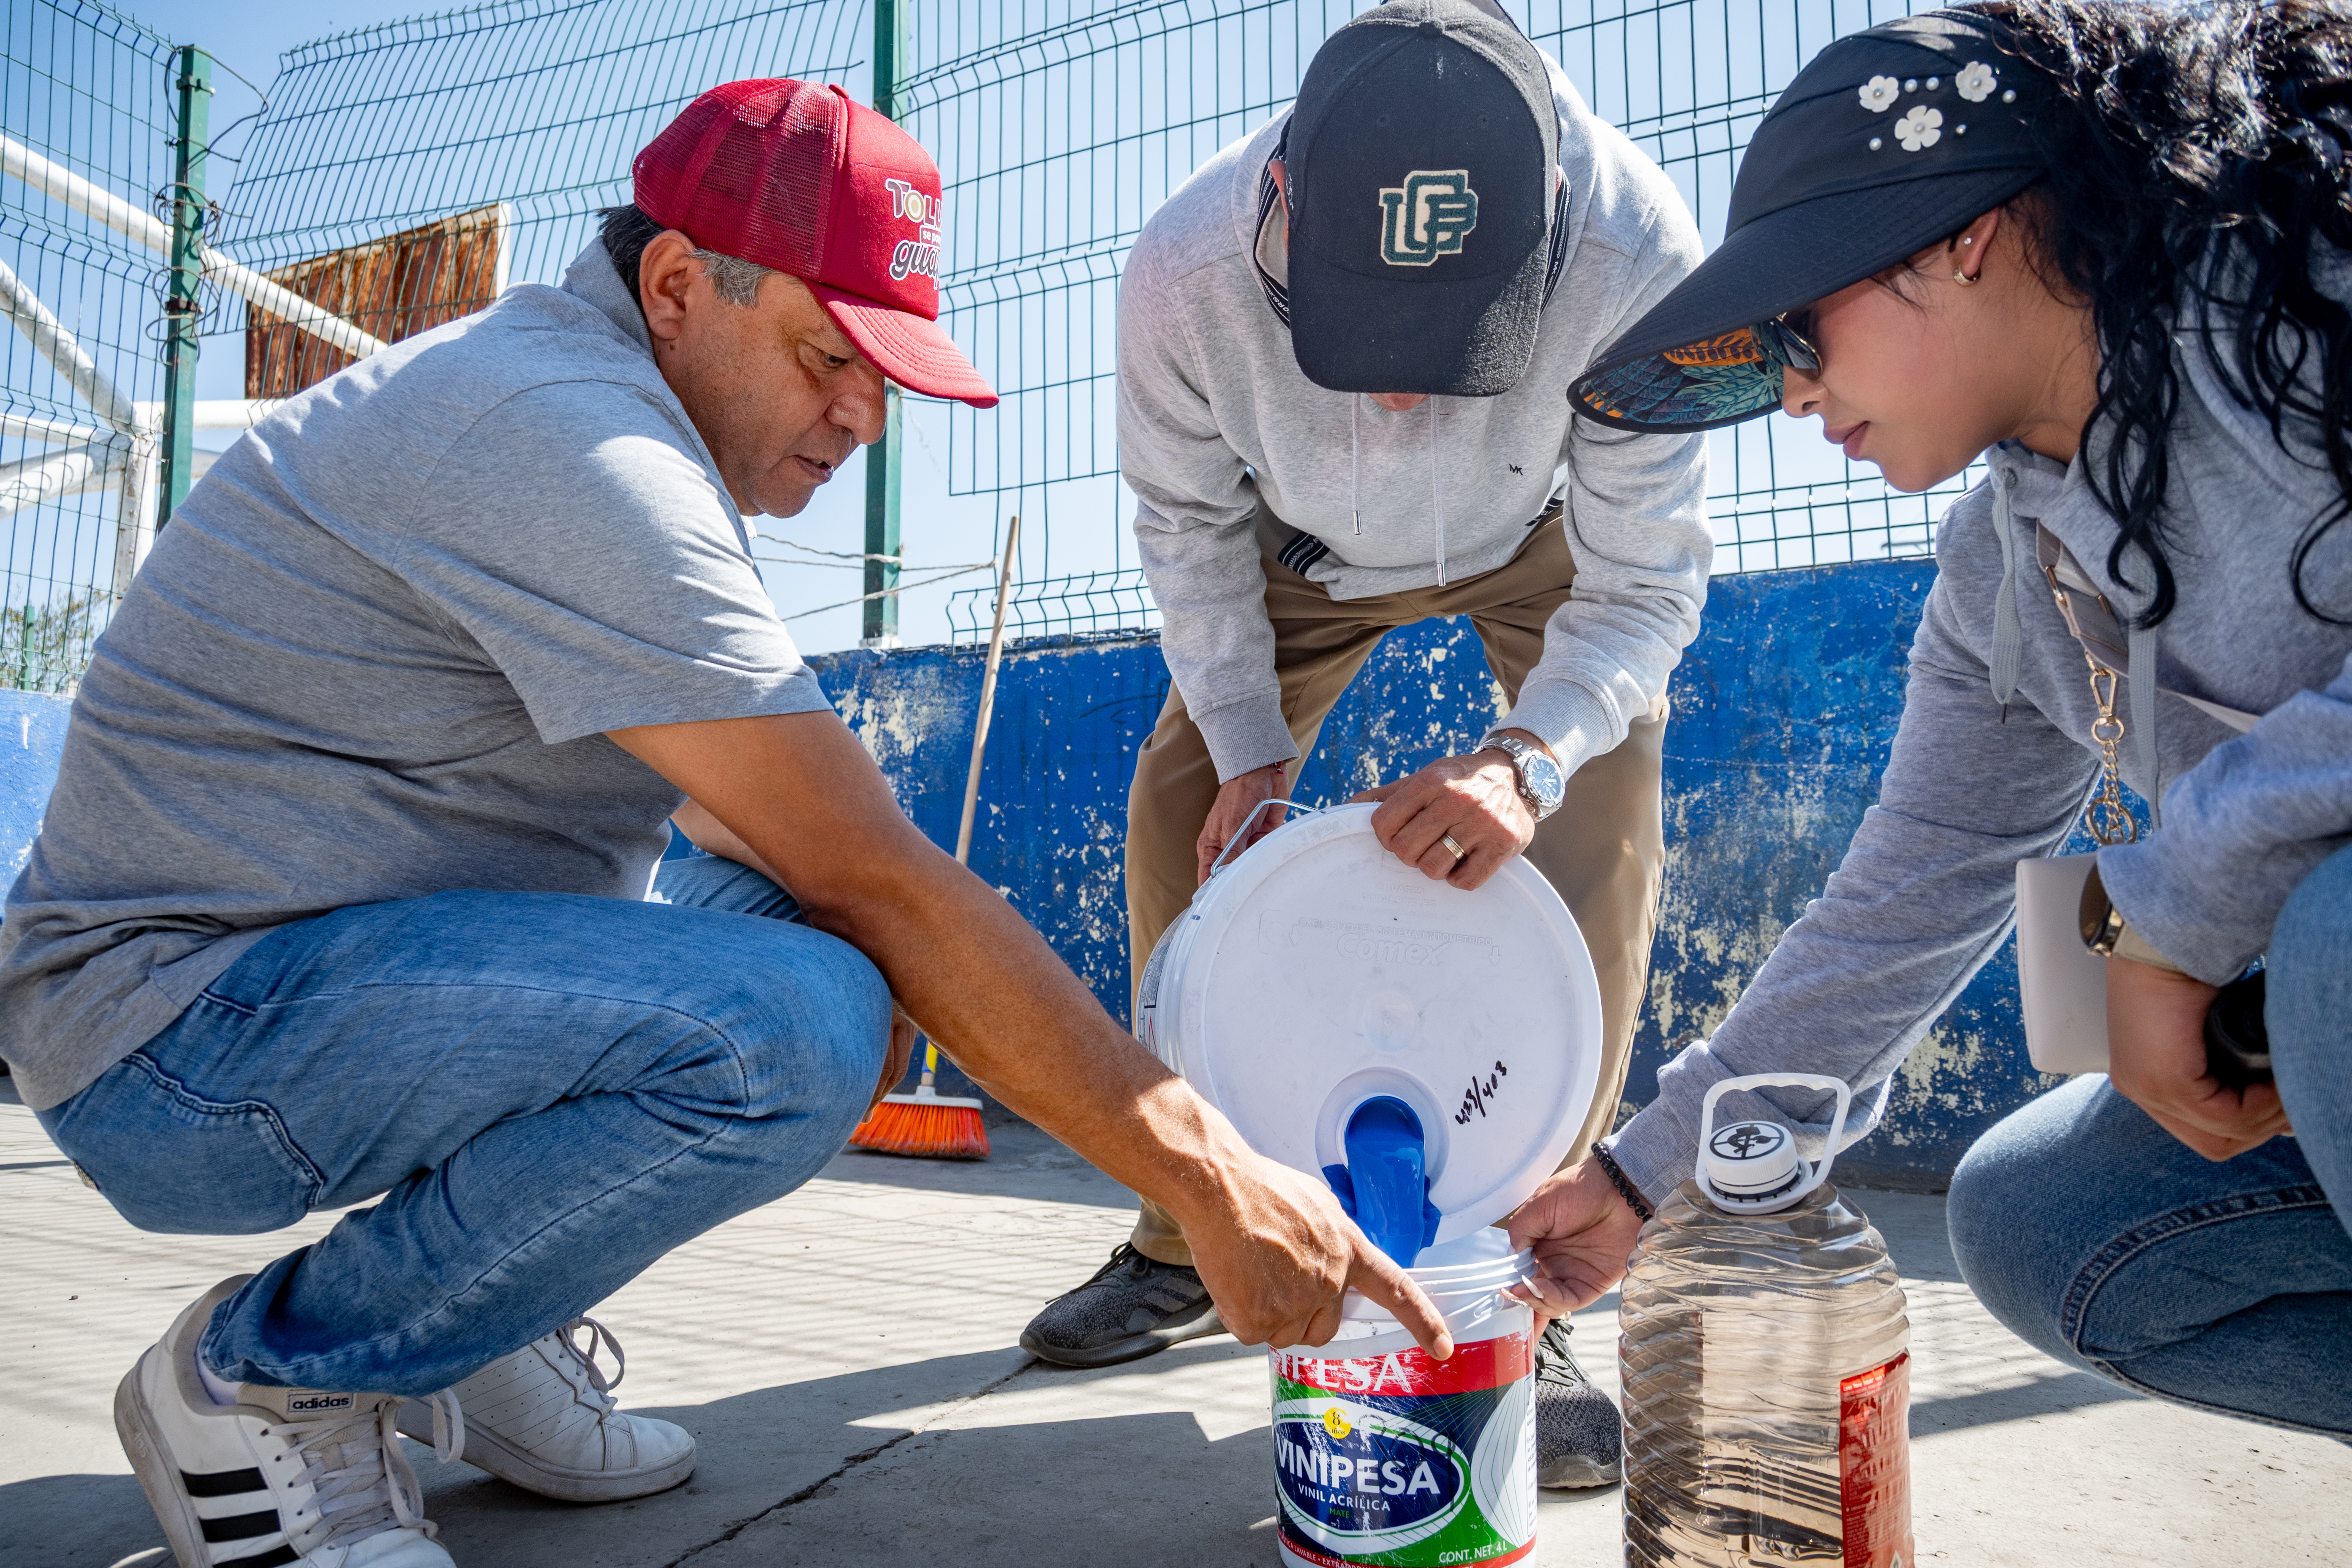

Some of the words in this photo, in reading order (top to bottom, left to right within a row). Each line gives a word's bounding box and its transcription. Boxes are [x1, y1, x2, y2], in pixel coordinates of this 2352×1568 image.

[923, 230, 931, 240] se
[1273, 297, 1289, 313] ORS
[1509, 463, 1523, 476] MK
[1300, 918, 1354, 931] EXCLUSIVO
[1356, 923, 1373, 933] DEL
[1377, 926, 1418, 938] SISTEMA
[1421, 931, 1493, 946] TINTOMETRICO
[1337, 933, 1451, 966] Comex
[293, 1396, 349, 1409] adidas
[1333, 1411, 1340, 1426] 8
[1275, 1434, 1440, 1495] VINIPESA
[1298, 1482, 1326, 1502] VINIL
[1329, 1494, 1391, 1511] ACRÍLICA
[1330, 1507, 1350, 1519] MATE
[1294, 1545, 1316, 1562] LAVABLE
[1439, 1549, 1473, 1563] CONT.
[1475, 1544, 1494, 1558] NET.
[1496, 1542, 1502, 1553] 4
[1503, 1540, 1507, 1551] L
